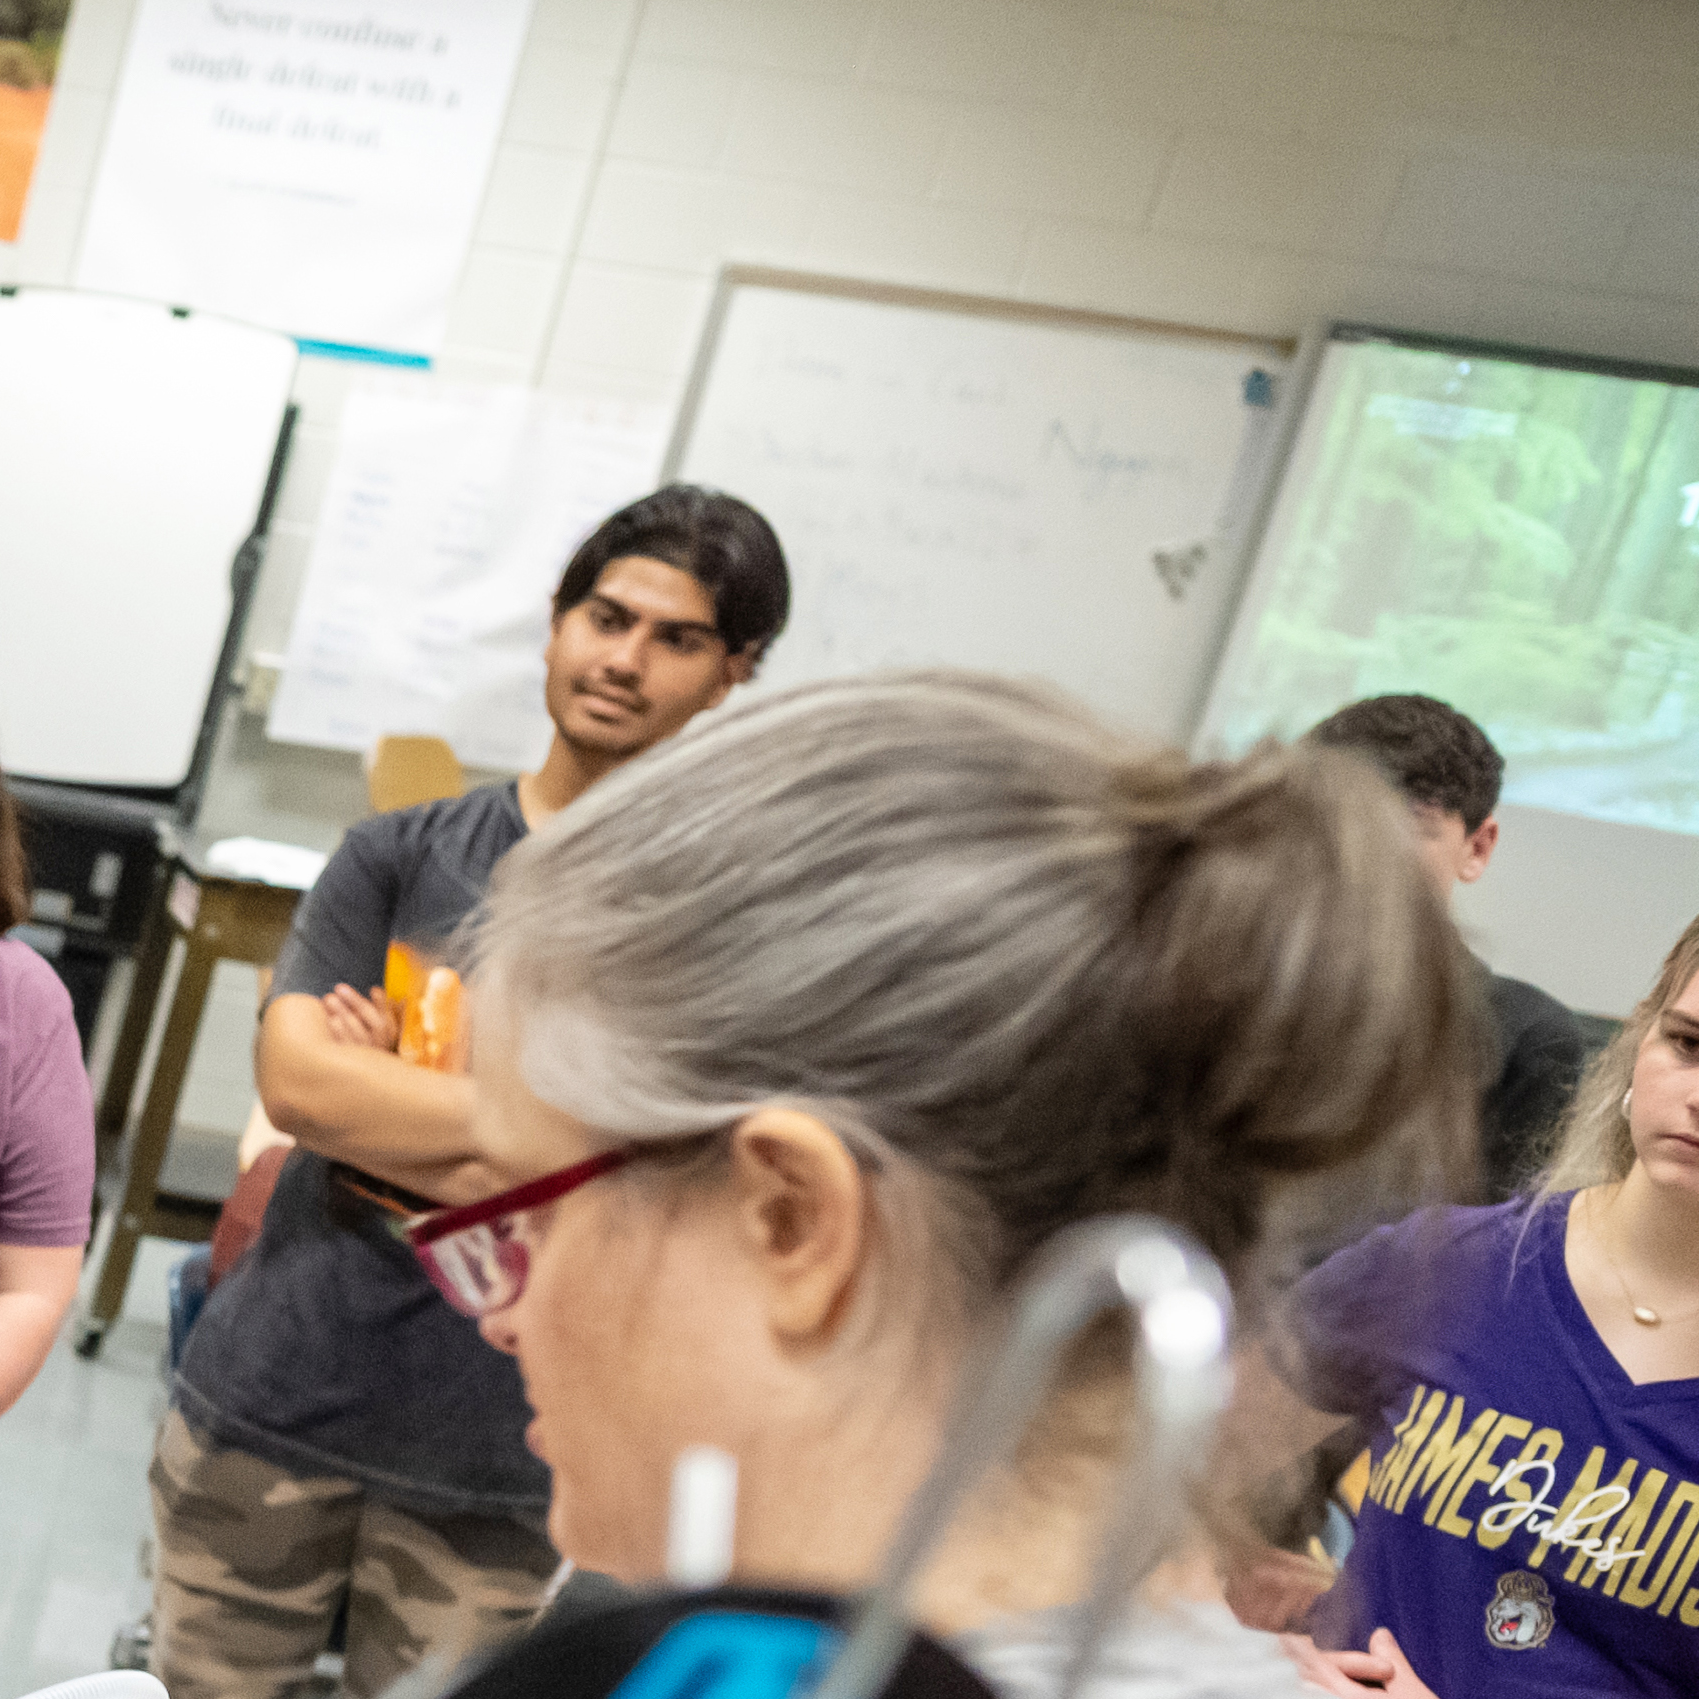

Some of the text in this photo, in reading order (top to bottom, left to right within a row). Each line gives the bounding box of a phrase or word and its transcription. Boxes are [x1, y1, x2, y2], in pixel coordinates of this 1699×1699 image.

[299, 13, 420, 50] confuse
[430, 31, 450, 54] a
[167, 44, 462, 109] single defeat with a
[212, 101, 281, 135] final
[1481, 1459, 1647, 1573] Dukes
